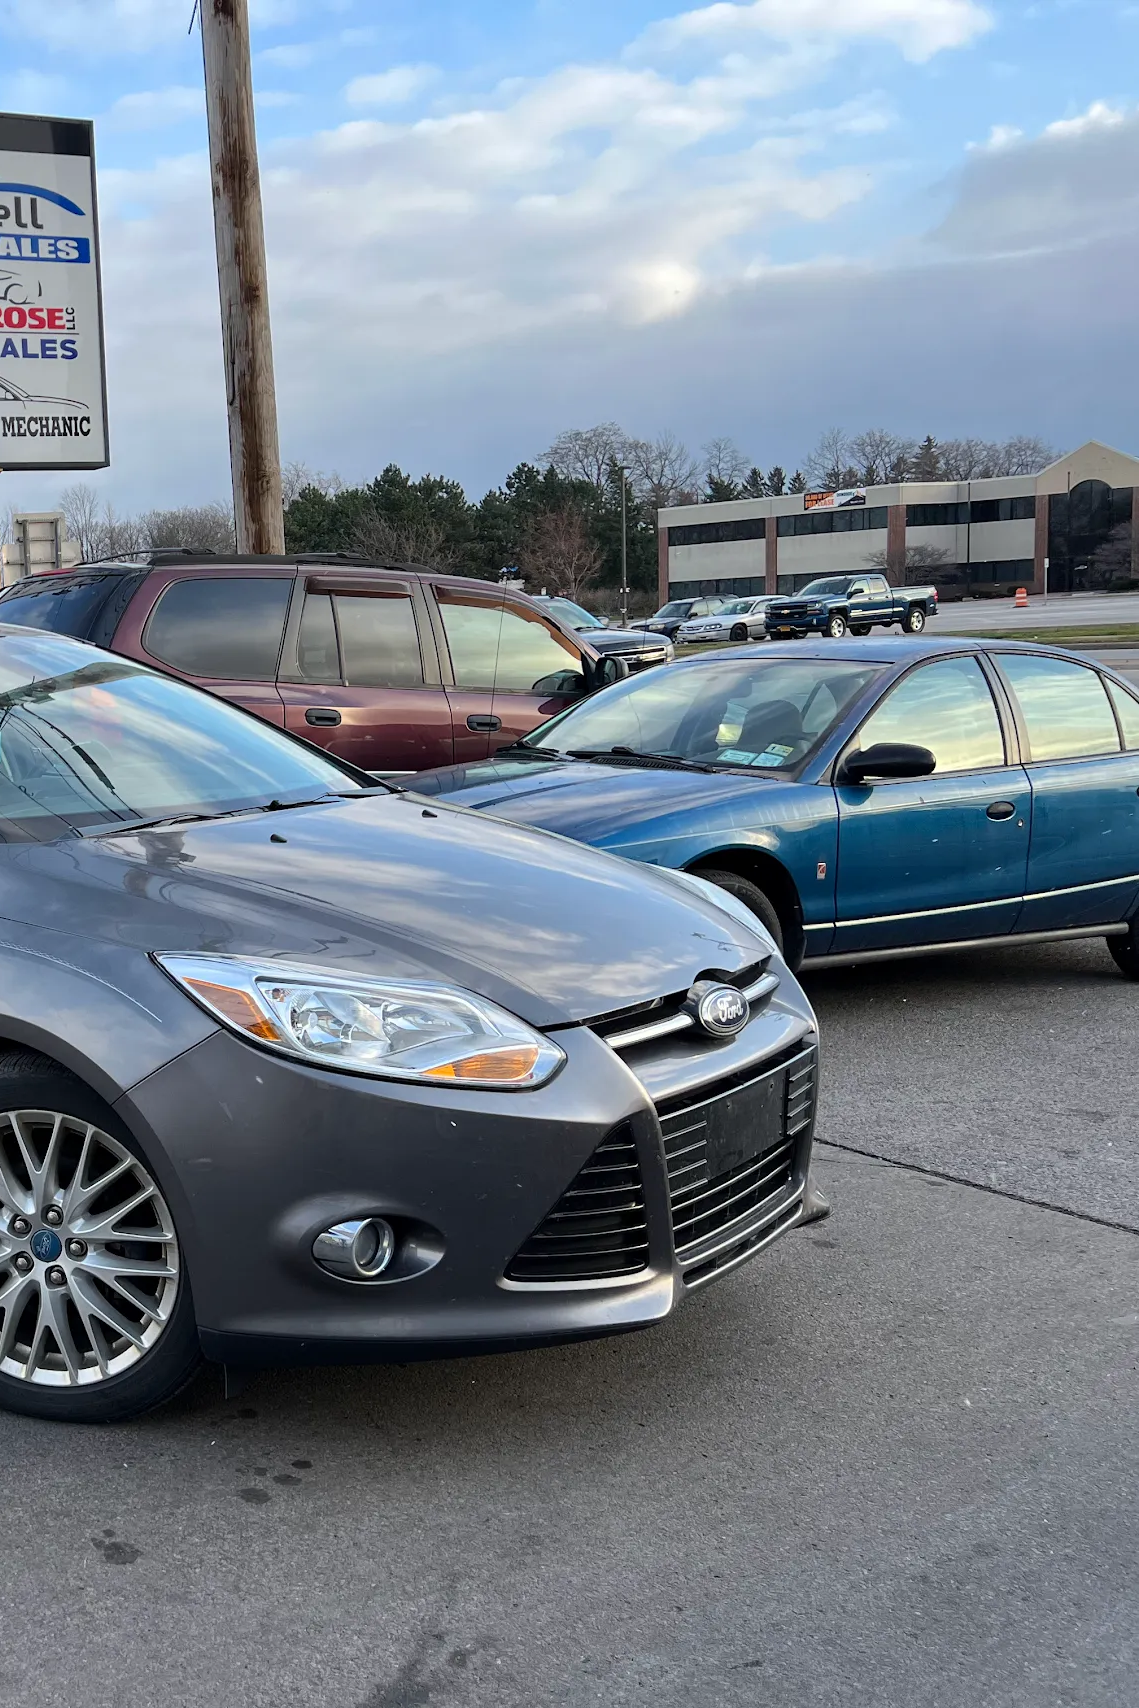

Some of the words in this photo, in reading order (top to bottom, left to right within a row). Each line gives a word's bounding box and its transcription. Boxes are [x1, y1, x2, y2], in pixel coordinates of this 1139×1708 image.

[65, 307, 75, 330] LLC
[1, 416, 91, 437] MECHANIC
[717, 996, 743, 1022] Ford
